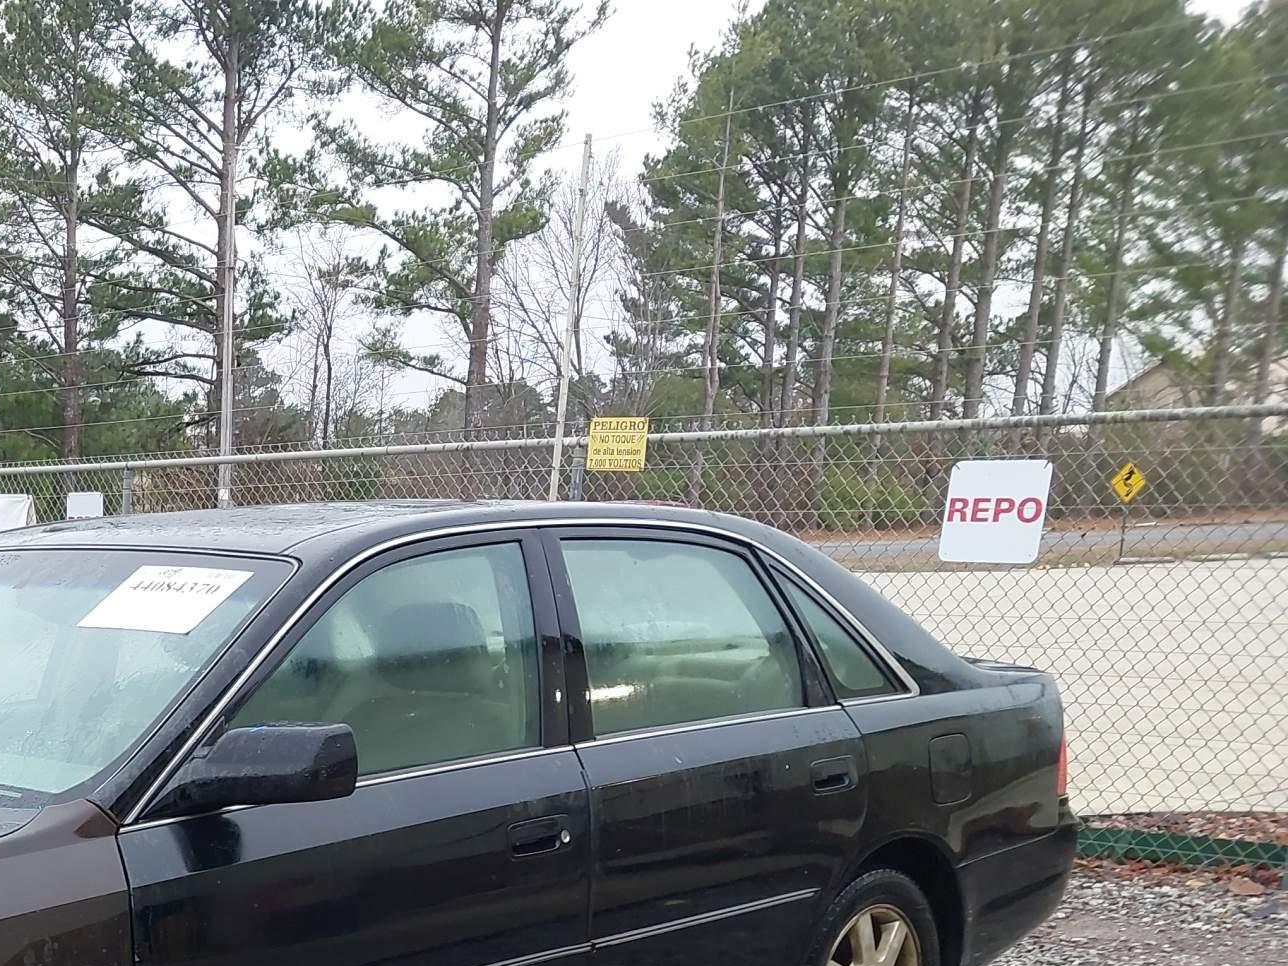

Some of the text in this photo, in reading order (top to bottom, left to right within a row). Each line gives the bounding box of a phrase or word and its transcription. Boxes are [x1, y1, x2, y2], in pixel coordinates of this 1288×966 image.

[593, 421, 645, 431] PELIGRO
[599, 434, 636, 444] NO TOQUE
[593, 448, 602, 456] de
[609, 459, 642, 469] VOLTIOS
[947, 497, 1043, 523] REPO
